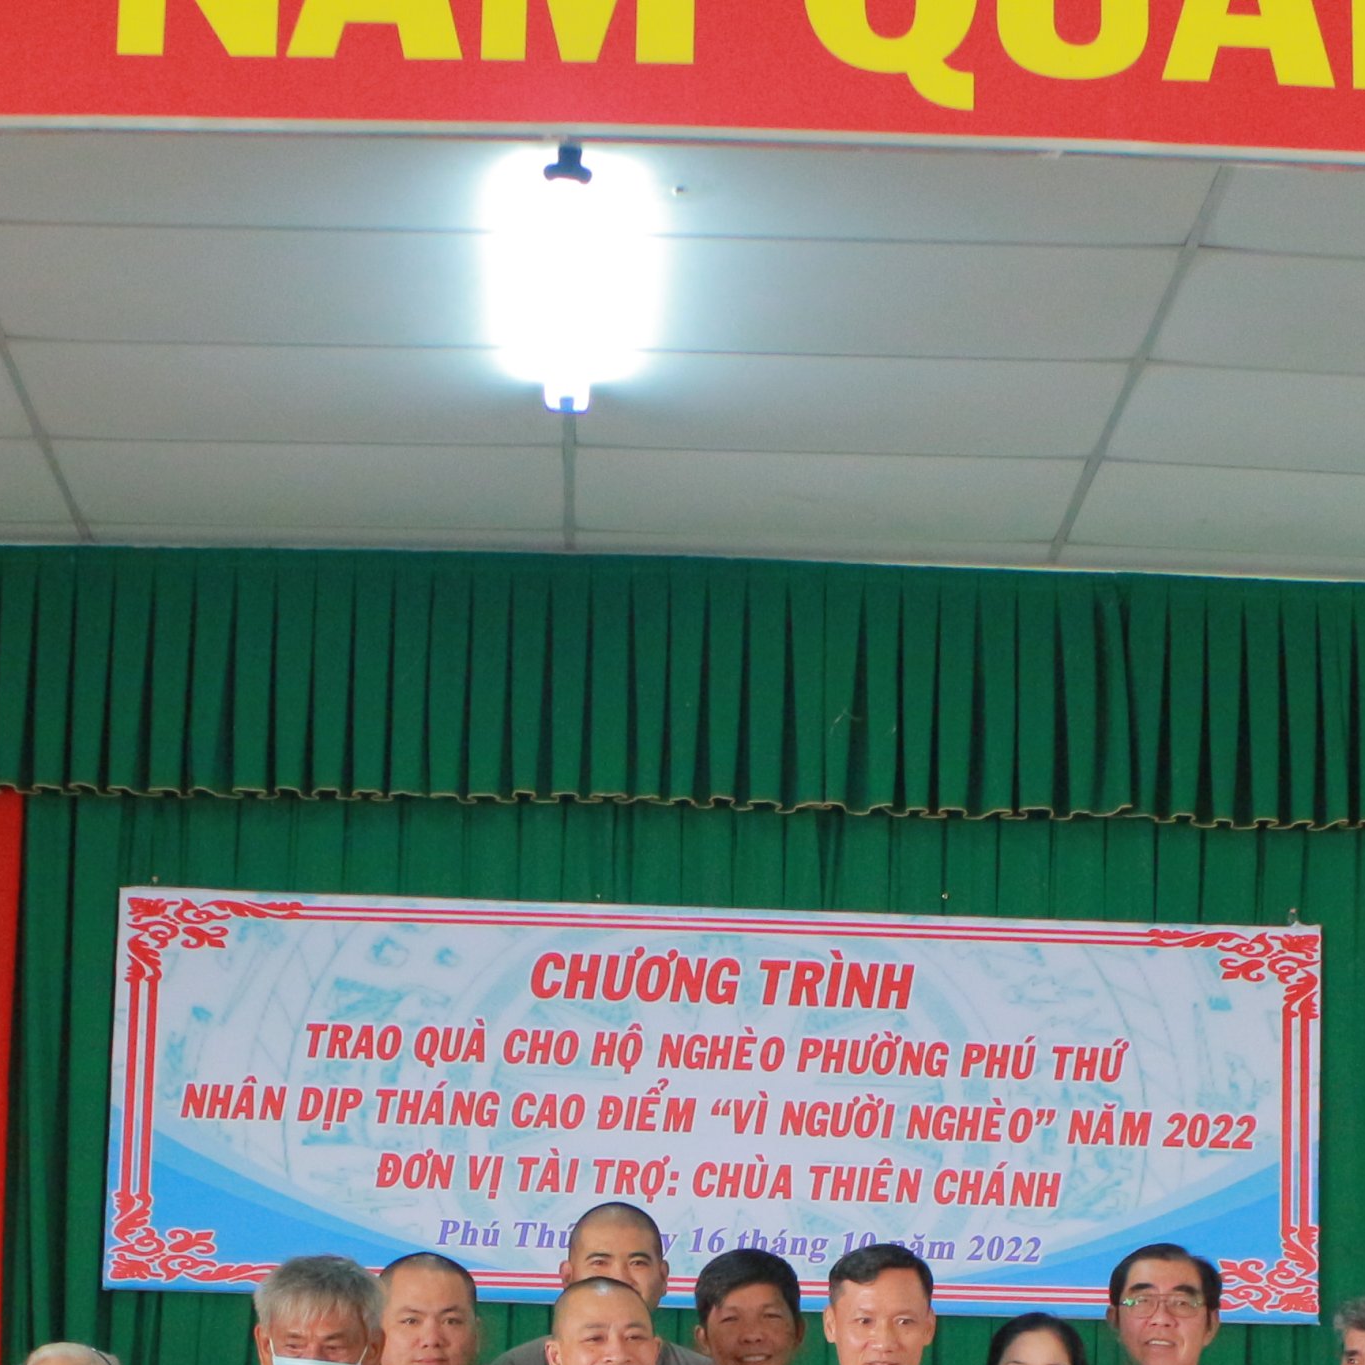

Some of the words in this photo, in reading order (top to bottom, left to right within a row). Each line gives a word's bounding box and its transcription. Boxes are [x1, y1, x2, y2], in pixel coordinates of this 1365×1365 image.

[531, 947, 741, 1005] CHƯƠNG
[760, 950, 914, 1009] TRÌNH
[307, 1023, 402, 1061] TRAO
[415, 1020, 485, 1068] QUÀ
[504, 1029, 580, 1066] CHO
[592, 1023, 643, 1073] HỘ
[658, 1027, 785, 1072] NGHÈO
[797, 1032, 949, 1077] PHƯỜNG
[961, 1037, 1036, 1080] PHÚ
[1052, 1039, 1129, 1083] THỨ
[182, 1076, 287, 1121] NHÂN
[298, 1087, 363, 1131] DỊP
[377, 1084, 500, 1127] THÁNG
[512, 1093, 586, 1130] CAO
[598, 1079, 696, 1132] ĐIỂM
[780, 1094, 895, 1138] NGƯỜI
[1068, 1105, 1152, 1146] NĂM
[1162, 1113, 1256, 1150] 2022
[377, 1150, 455, 1189] ĐƠN
[469, 1155, 503, 1199] VỊ
[518, 1149, 579, 1193] TÀI
[594, 1156, 679, 1203] TRỢ:
[693, 1155, 792, 1200] CHÙA
[810, 1158, 922, 1203] THIÊN
[934, 1164, 1061, 1208] CHÁNH
[435, 1219, 501, 1248] Phú
[688, 1227, 726, 1253] 16
[966, 1235, 1043, 1263] 2022
